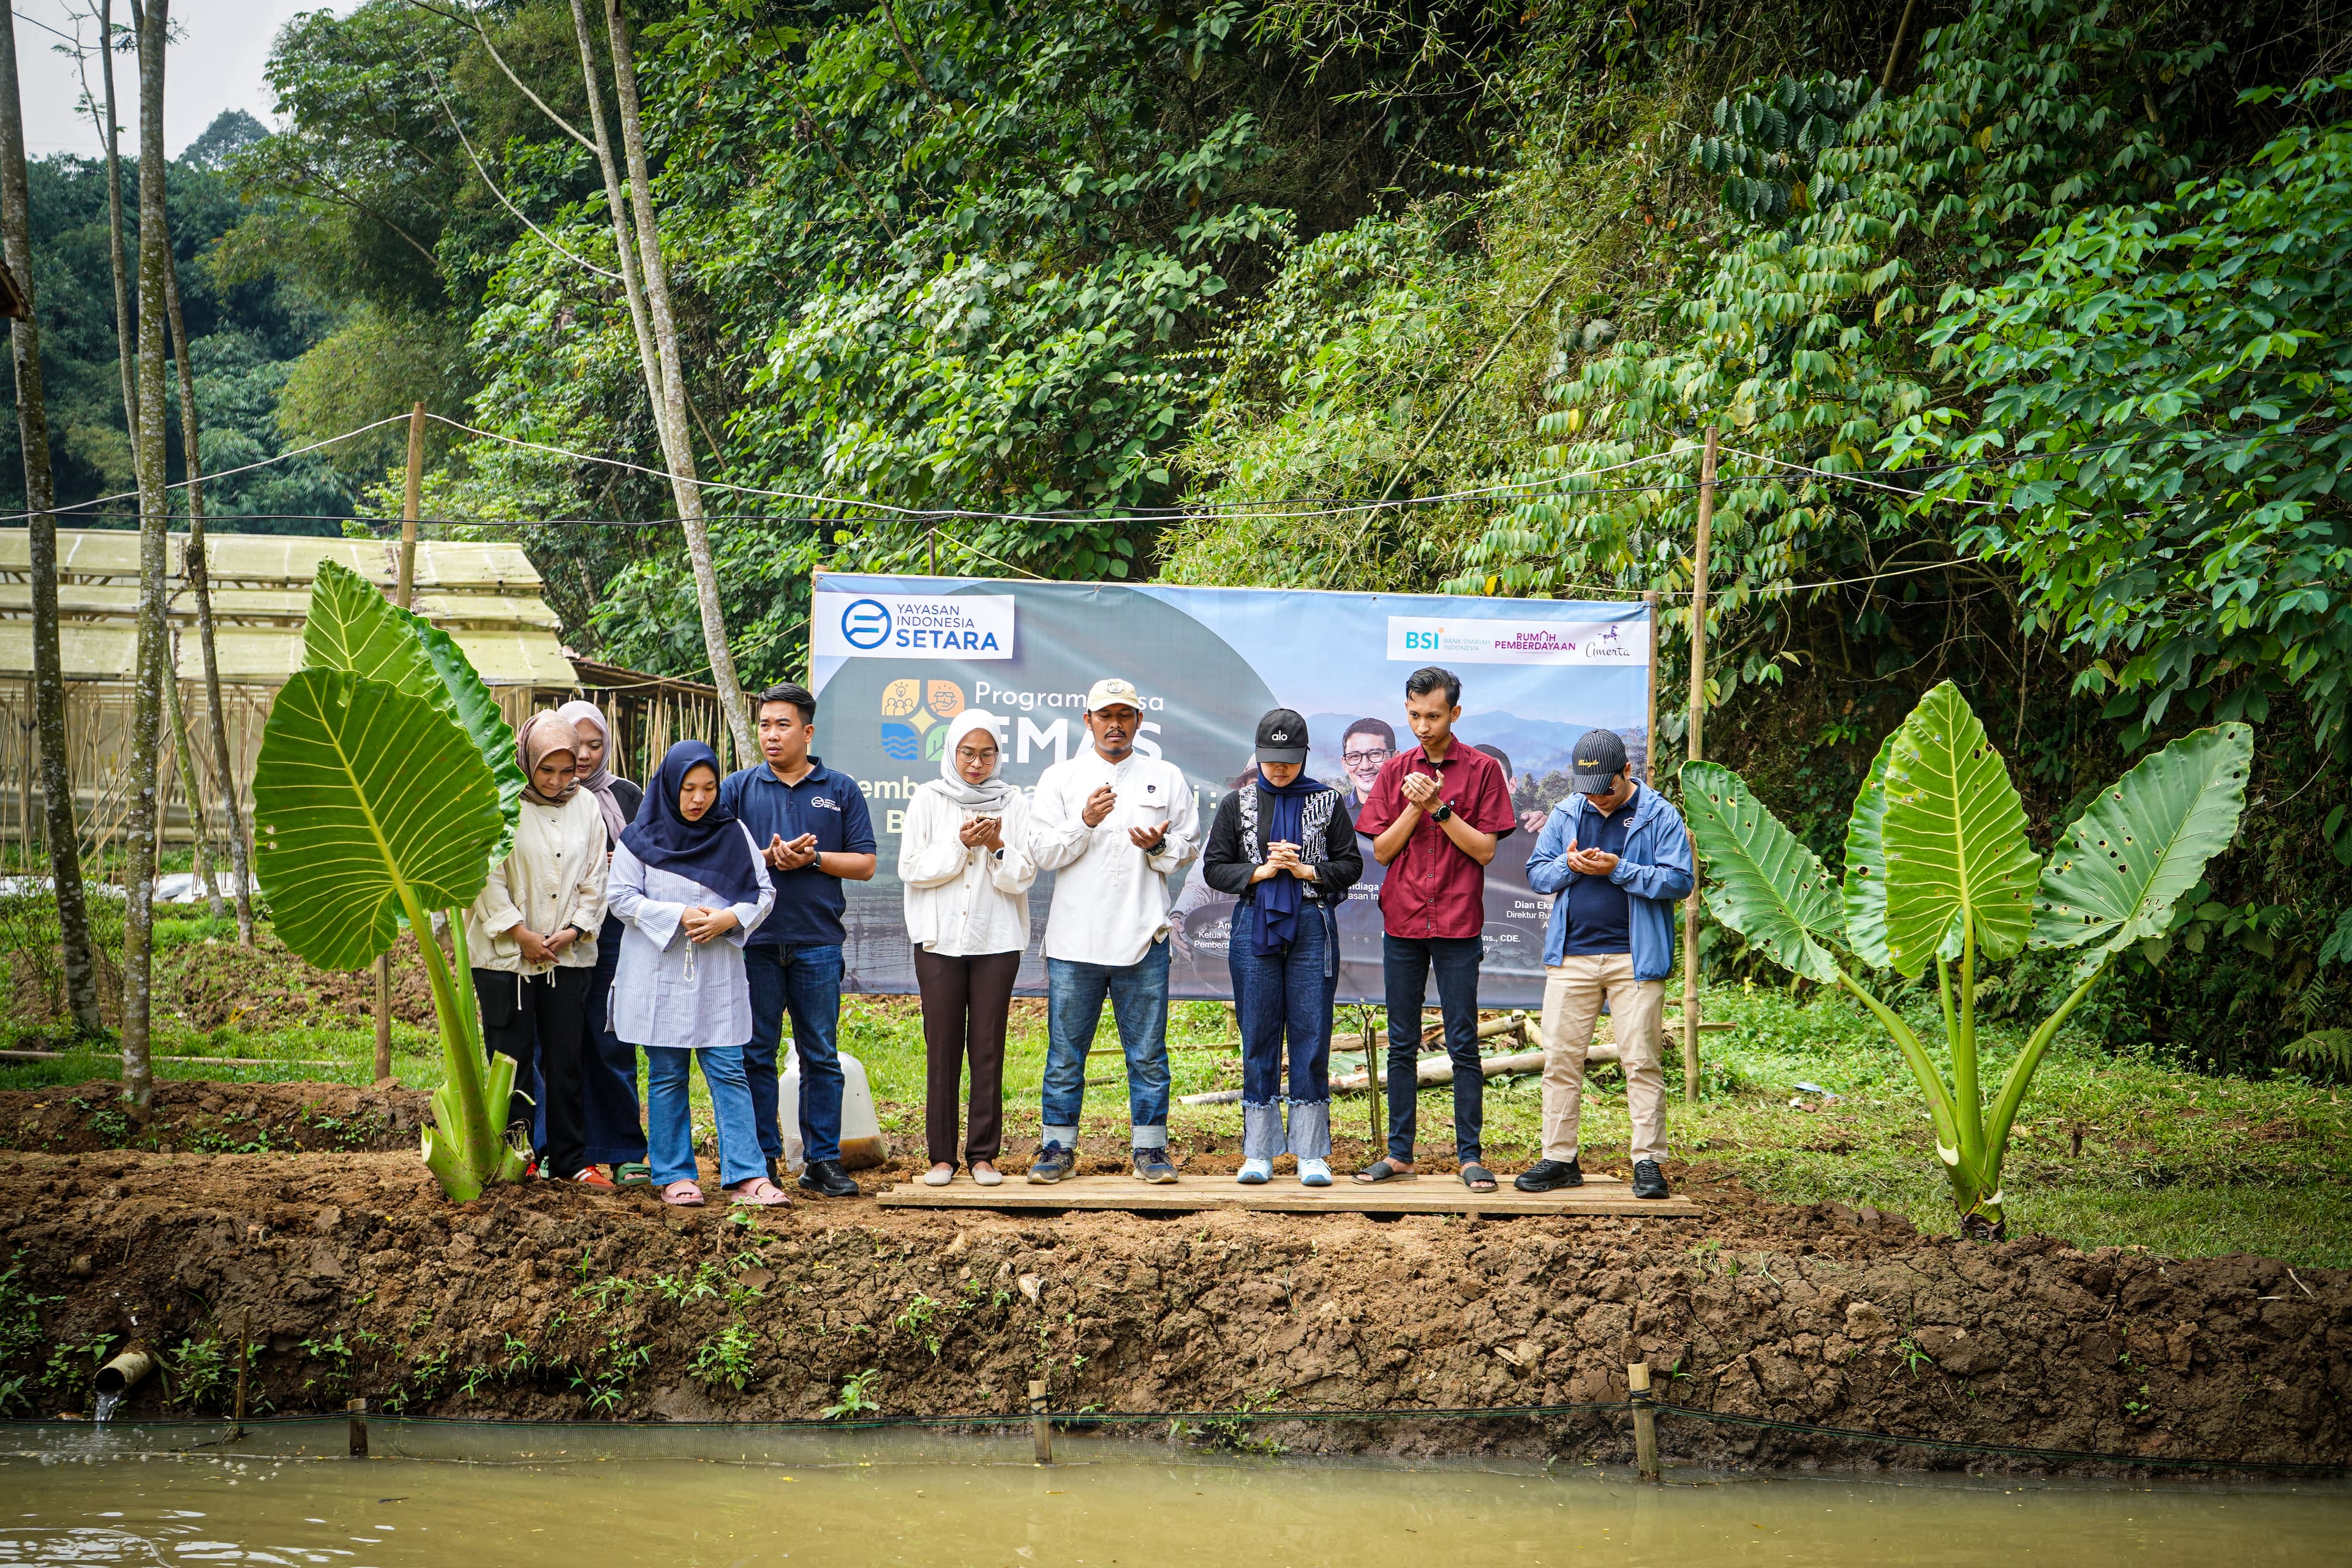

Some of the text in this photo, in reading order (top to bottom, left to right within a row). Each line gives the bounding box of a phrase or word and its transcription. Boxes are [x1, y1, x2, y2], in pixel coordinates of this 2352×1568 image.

[897, 603, 960, 616] YAYASAN
[897, 616, 975, 628] INDONESIA
[895, 628, 1000, 651] SETARA
[1406, 631, 1439, 650] BSI
[1494, 641, 1576, 651] PEMBERDAYAAN
[975, 681, 1087, 711] Program
[1272, 729, 1288, 741] alo
[1515, 900, 1554, 910] Dian Eka
[1507, 910, 1537, 919] Direktur
